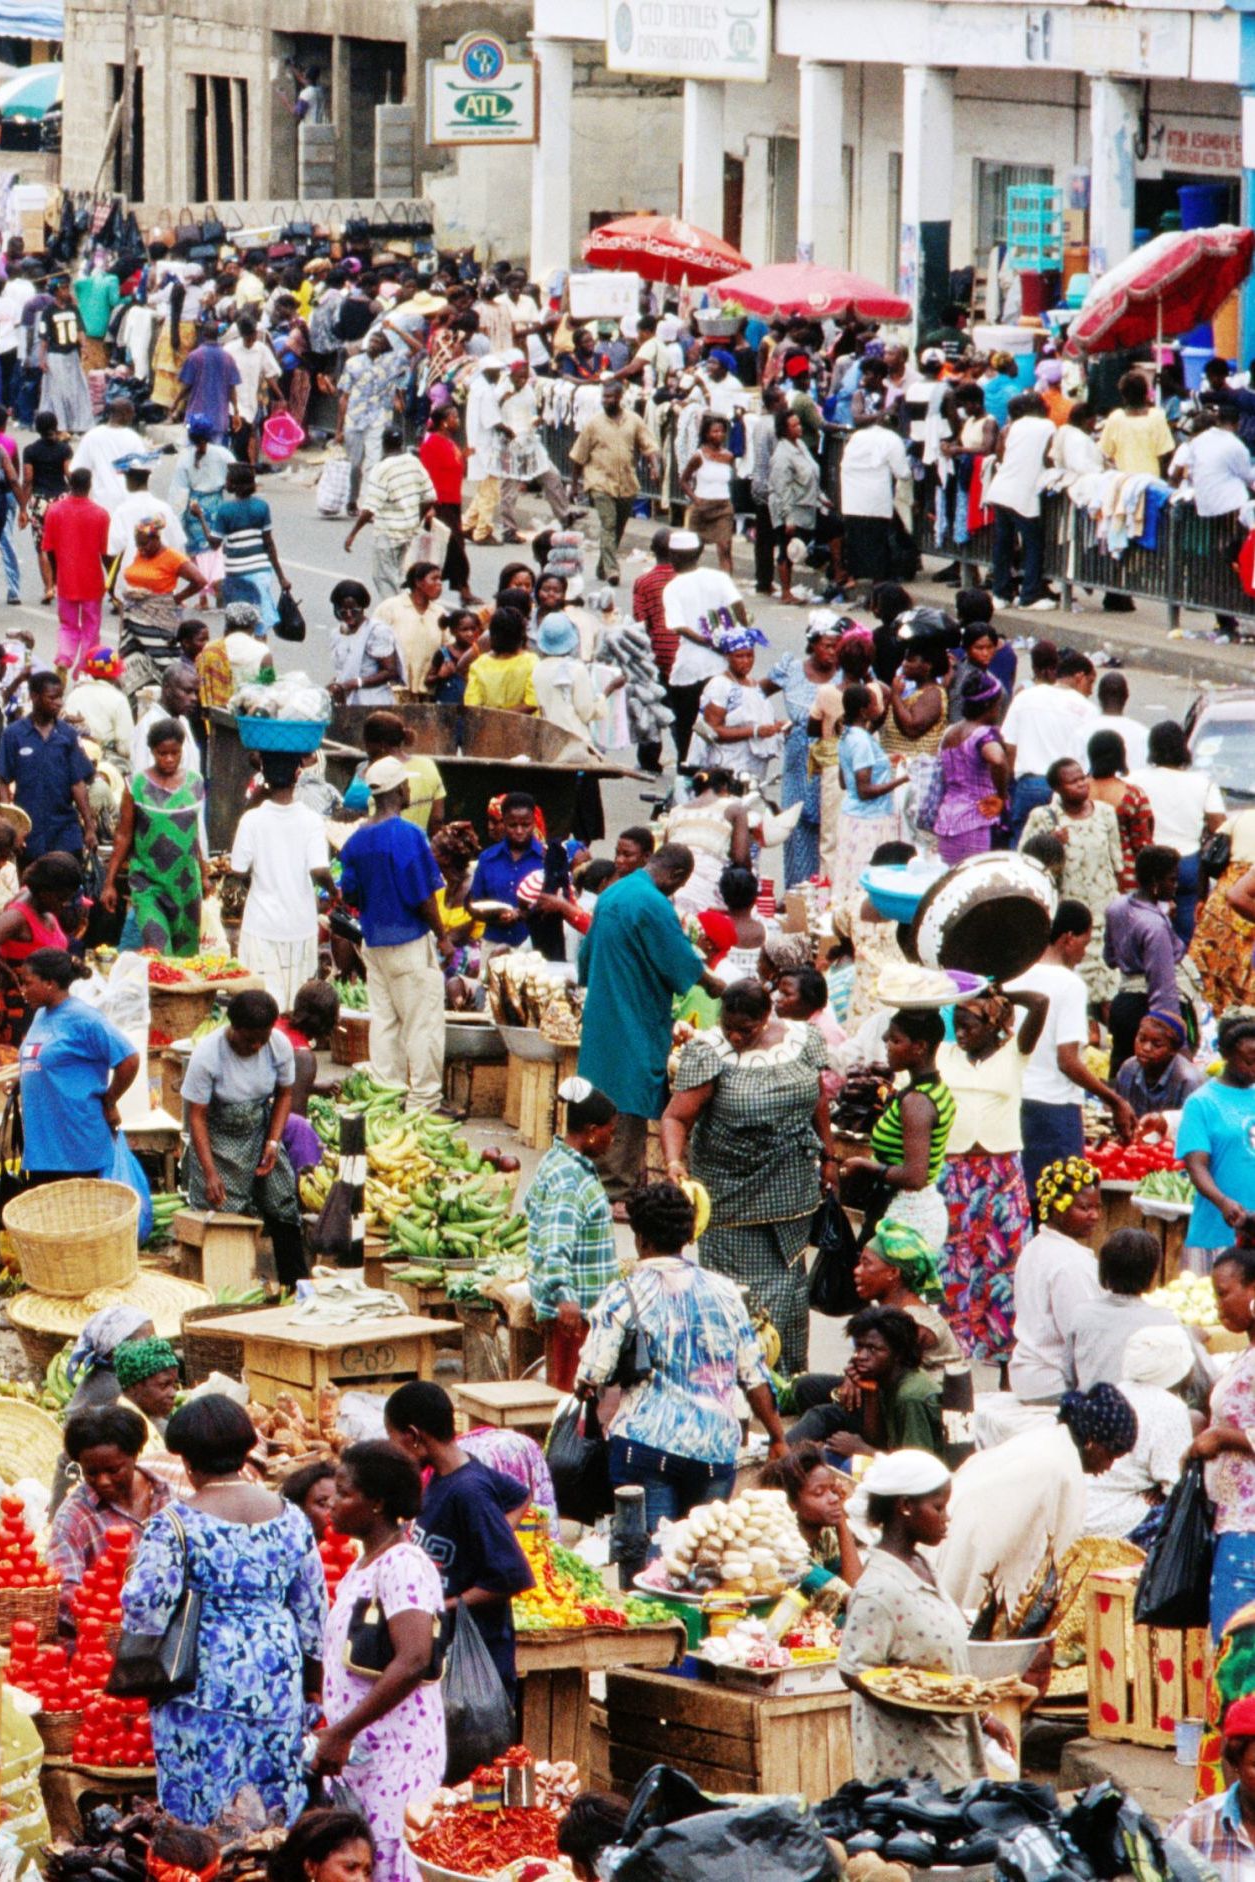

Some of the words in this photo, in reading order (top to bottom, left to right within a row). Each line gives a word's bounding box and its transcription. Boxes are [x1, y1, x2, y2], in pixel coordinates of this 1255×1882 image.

[667, 4, 718, 29] TEXTILES
[637, 35, 720, 61] DISTRIBUTION
[464, 94, 506, 117] ATL
